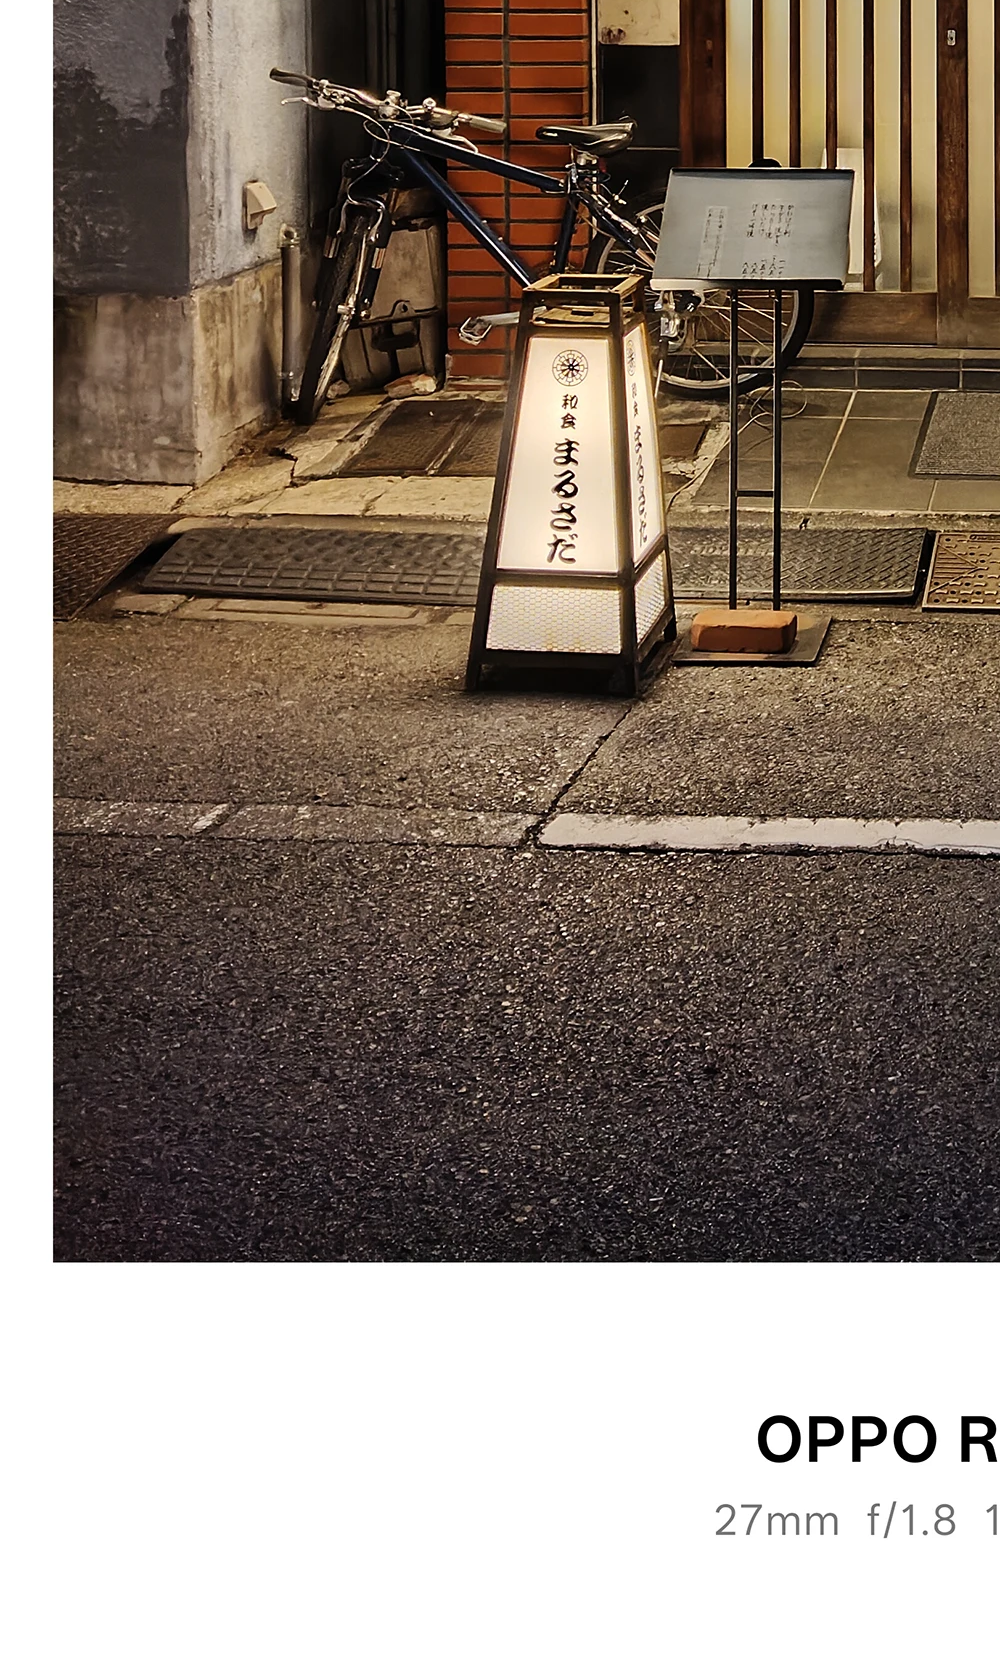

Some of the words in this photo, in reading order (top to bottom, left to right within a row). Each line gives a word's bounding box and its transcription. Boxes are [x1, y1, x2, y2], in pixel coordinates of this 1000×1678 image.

[560, 393, 579, 430] 和食
[546, 437, 580, 564] まるさだ
